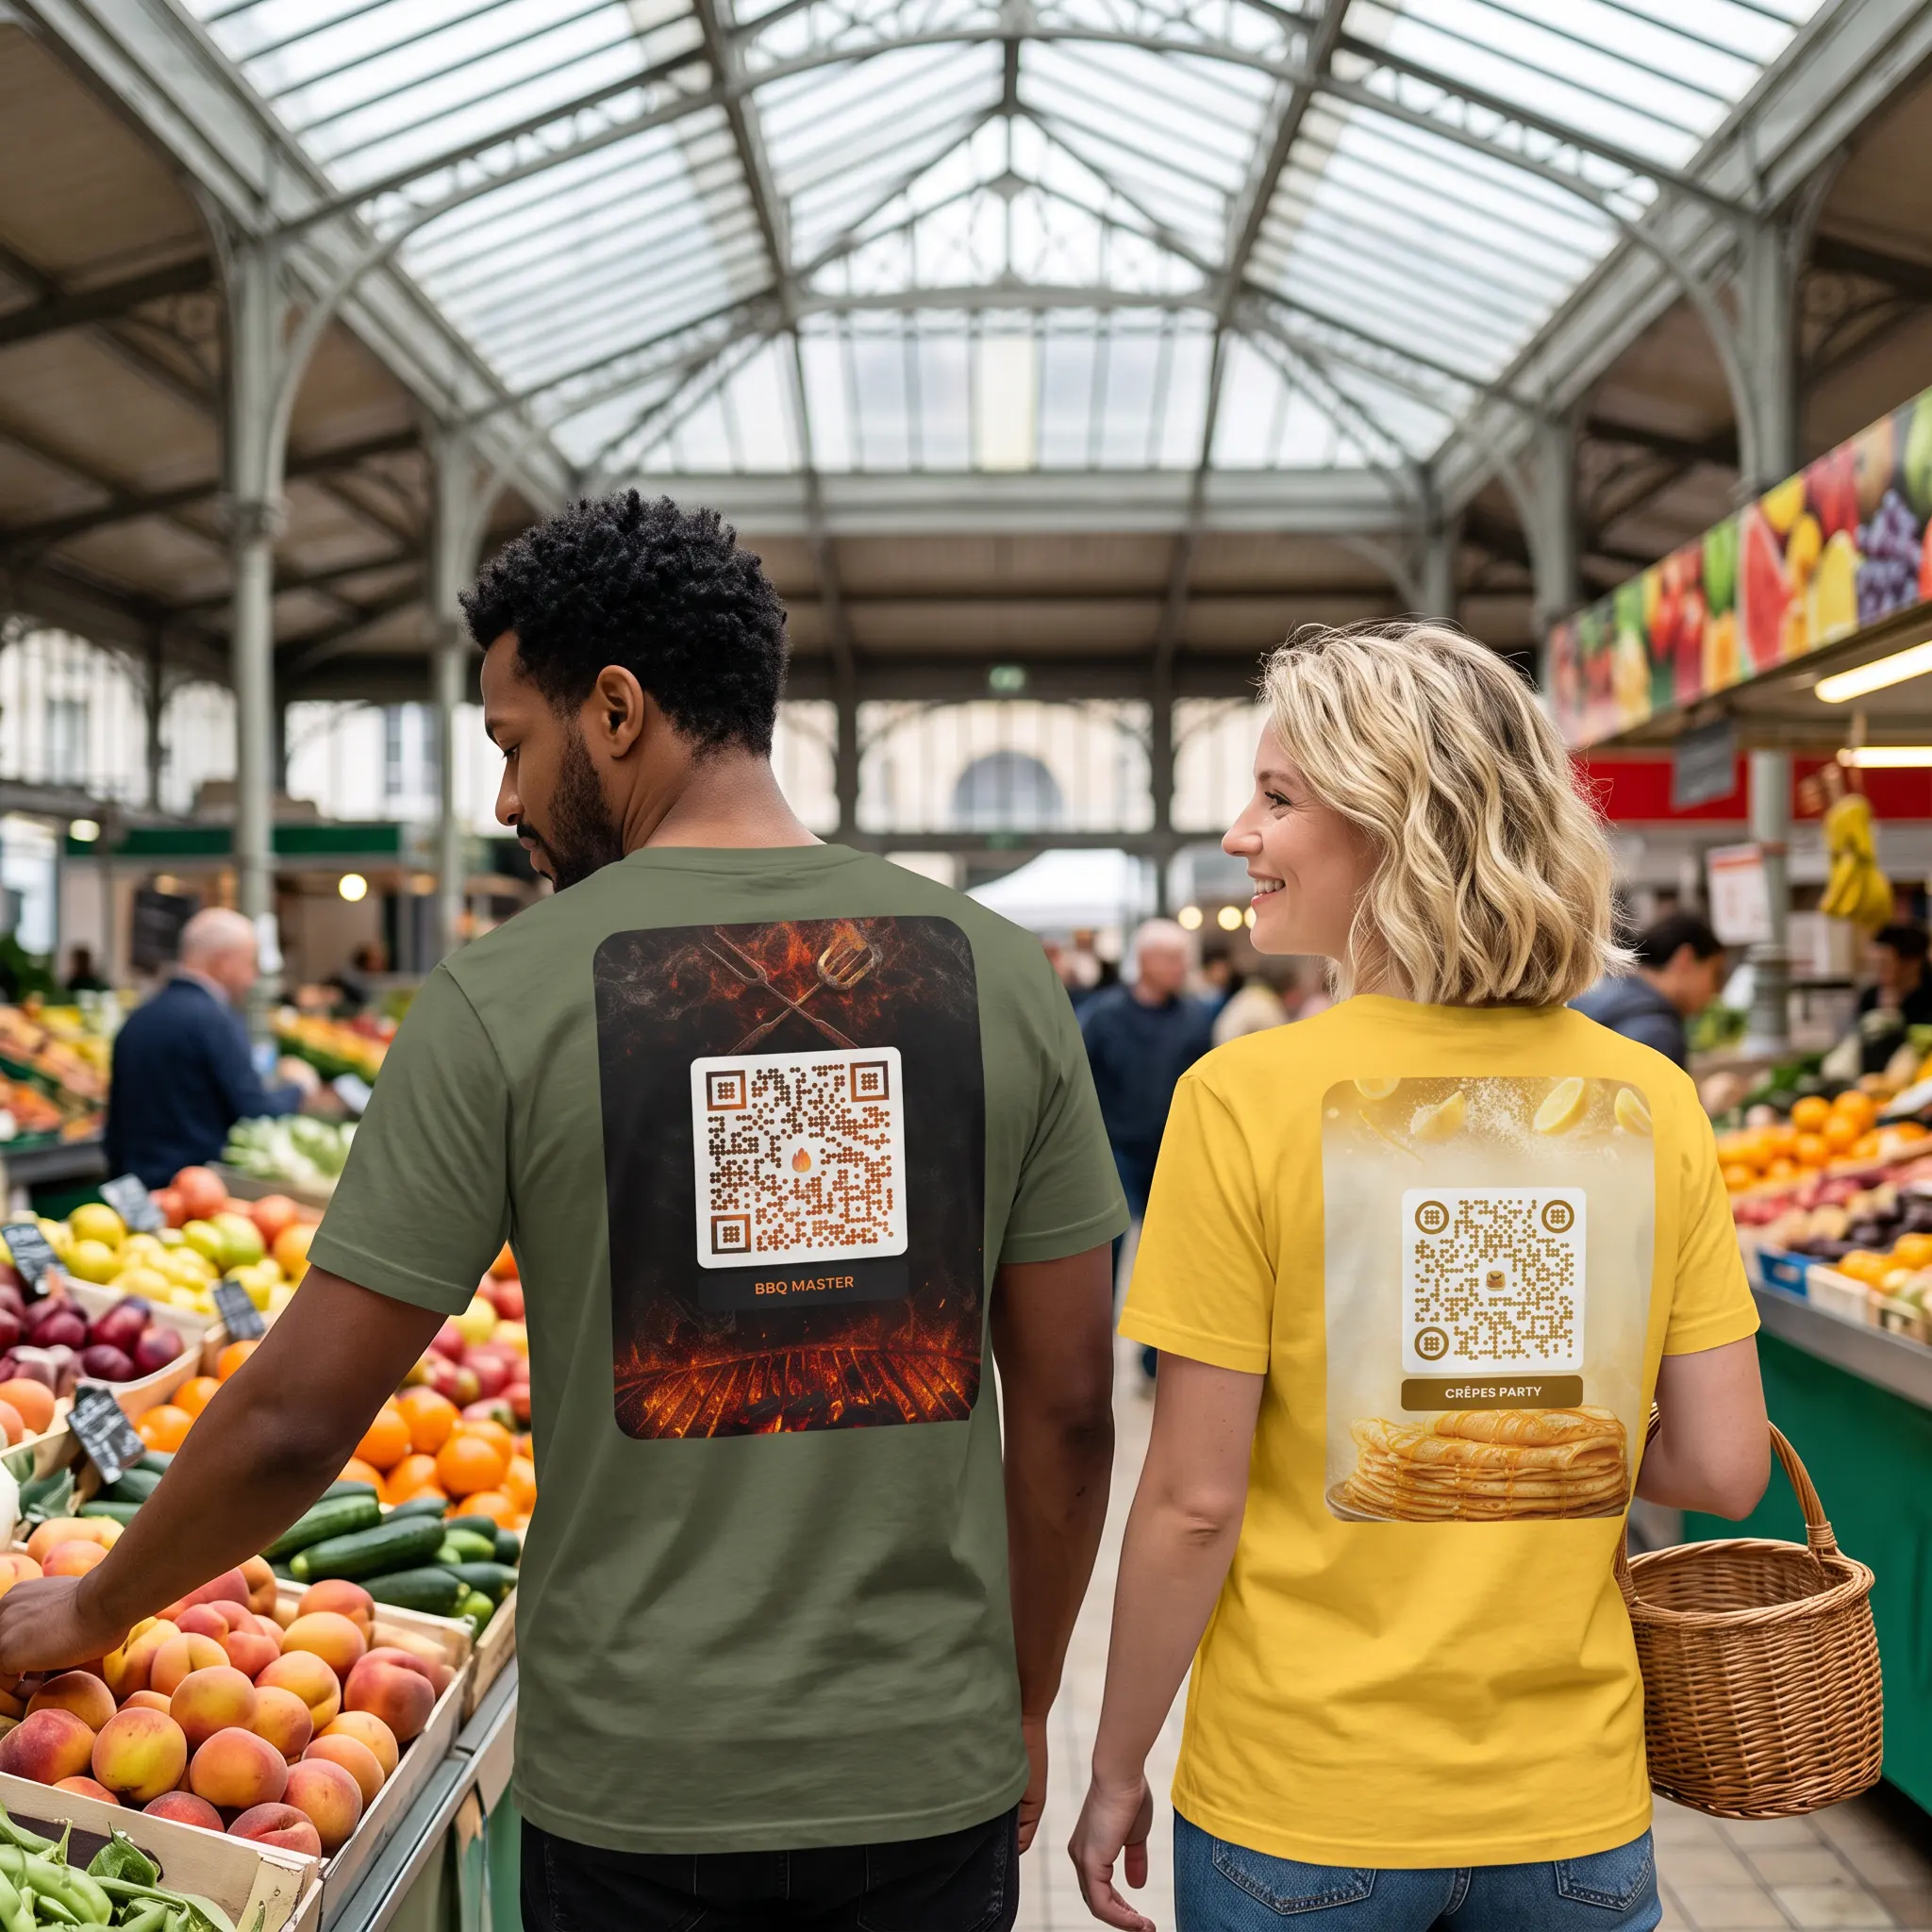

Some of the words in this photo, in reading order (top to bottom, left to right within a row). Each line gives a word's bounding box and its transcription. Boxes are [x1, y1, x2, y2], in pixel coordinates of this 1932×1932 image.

[755, 1281, 788, 1295] BBQ
[791, 1275, 854, 1291] MASTER
[1444, 1385, 1496, 1399] CRÊPES
[1499, 1386, 1542, 1397] PARTY
